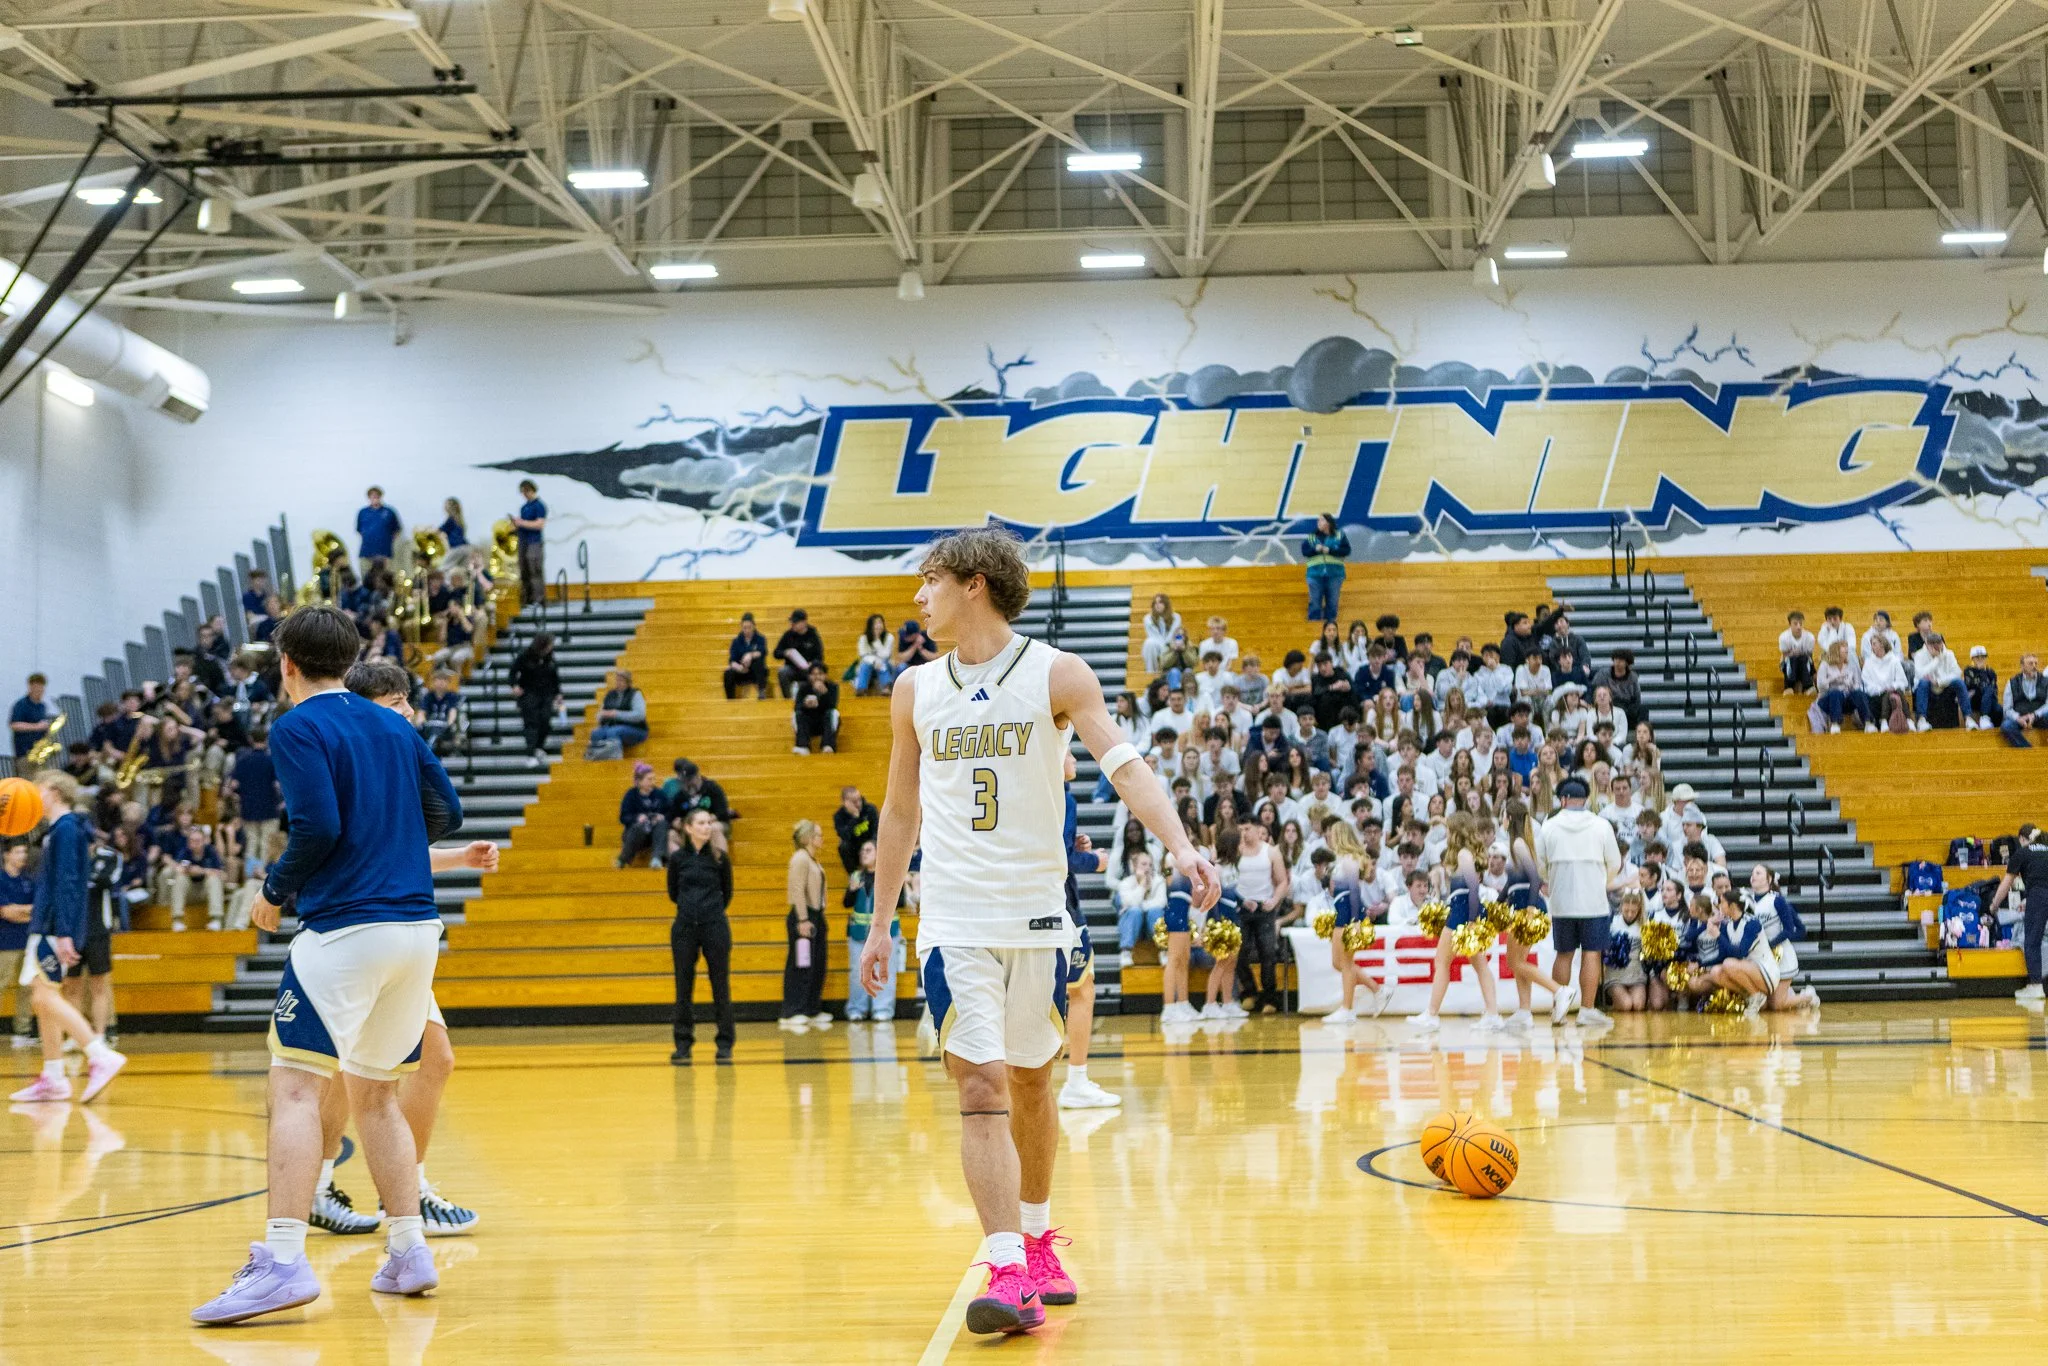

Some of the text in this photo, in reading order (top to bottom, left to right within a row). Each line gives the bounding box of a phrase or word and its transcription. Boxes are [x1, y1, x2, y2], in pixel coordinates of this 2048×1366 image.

[813, 386, 1935, 536] LIGHTNING
[932, 721, 1034, 761] LEGACY
[972, 767, 999, 831] 3
[1490, 1138, 1518, 1171] Wilso
